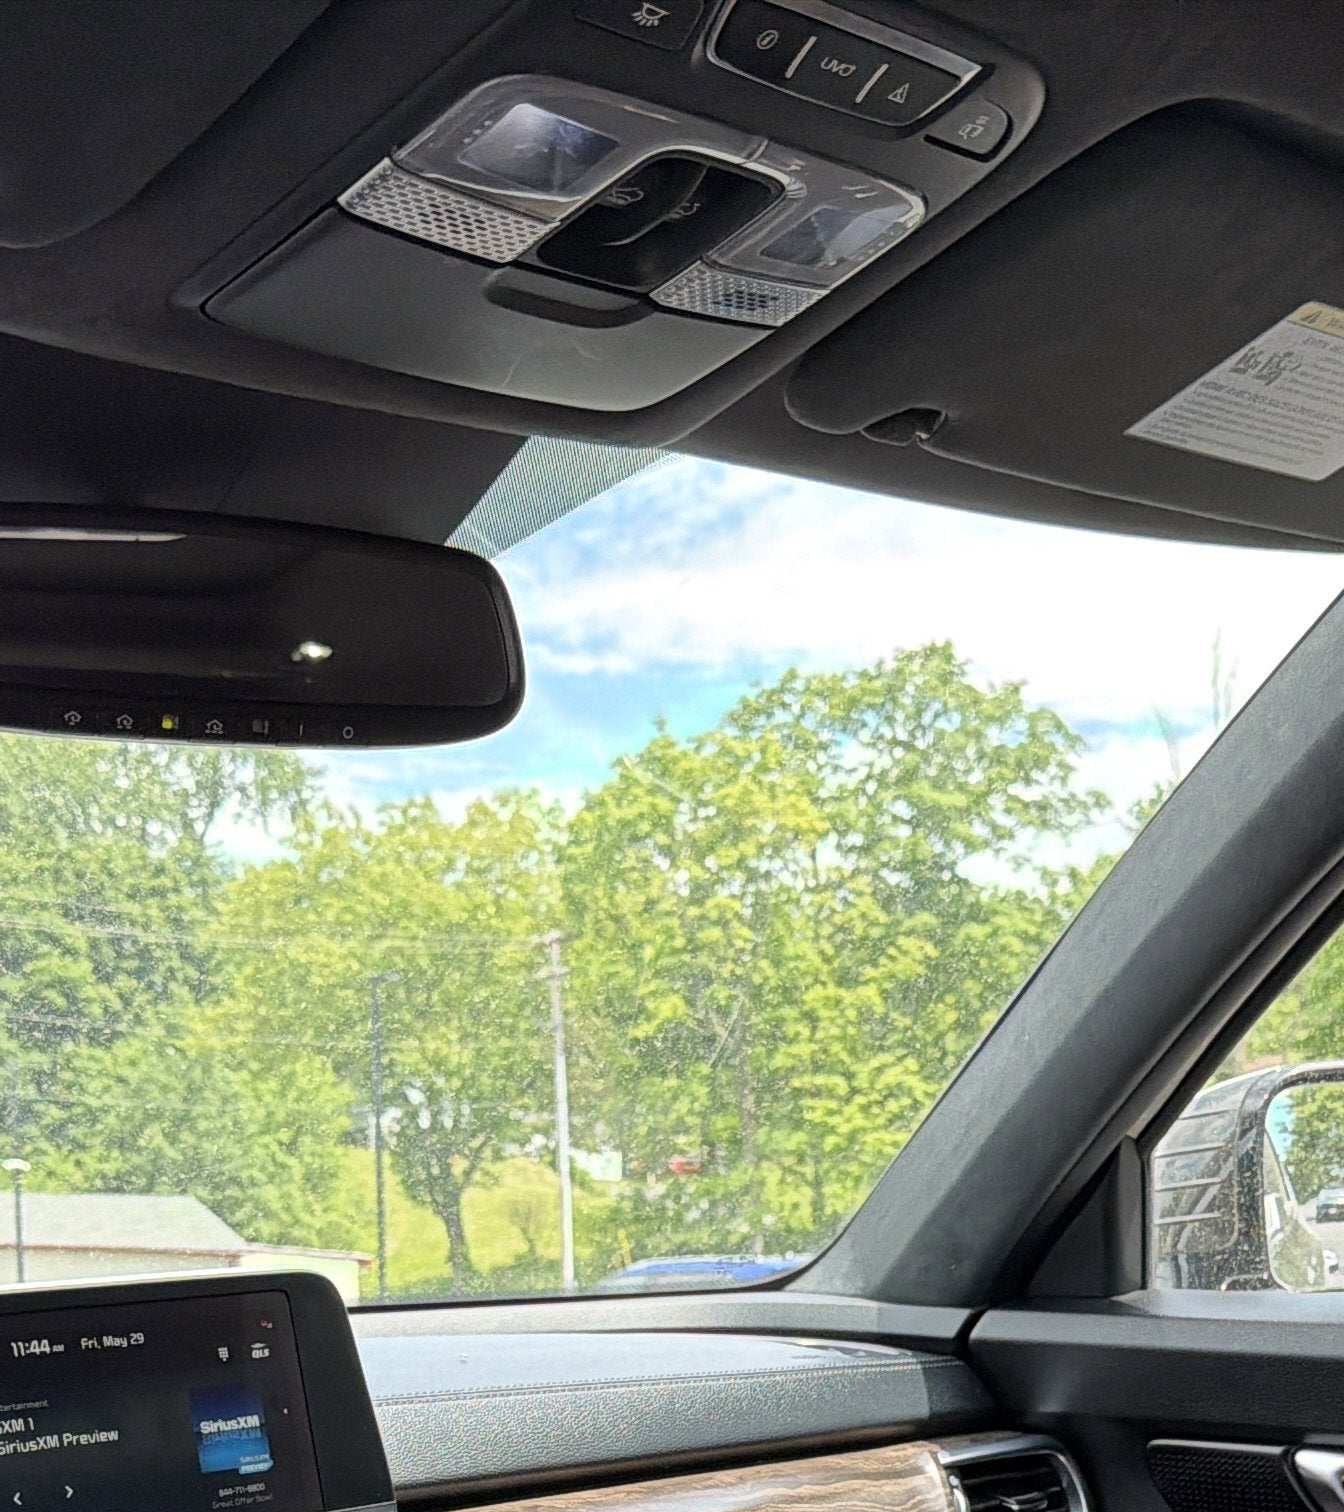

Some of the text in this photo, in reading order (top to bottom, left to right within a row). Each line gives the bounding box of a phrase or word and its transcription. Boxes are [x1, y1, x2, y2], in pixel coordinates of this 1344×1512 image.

[11, 1339, 51, 1357] 11:44
[81, 1333, 145, 1350] Fri, May 29
[27, 1417, 35, 1431] 1
[199, 1415, 261, 1434] SiriusXM
[62, 1429, 119, 1447] Preview
